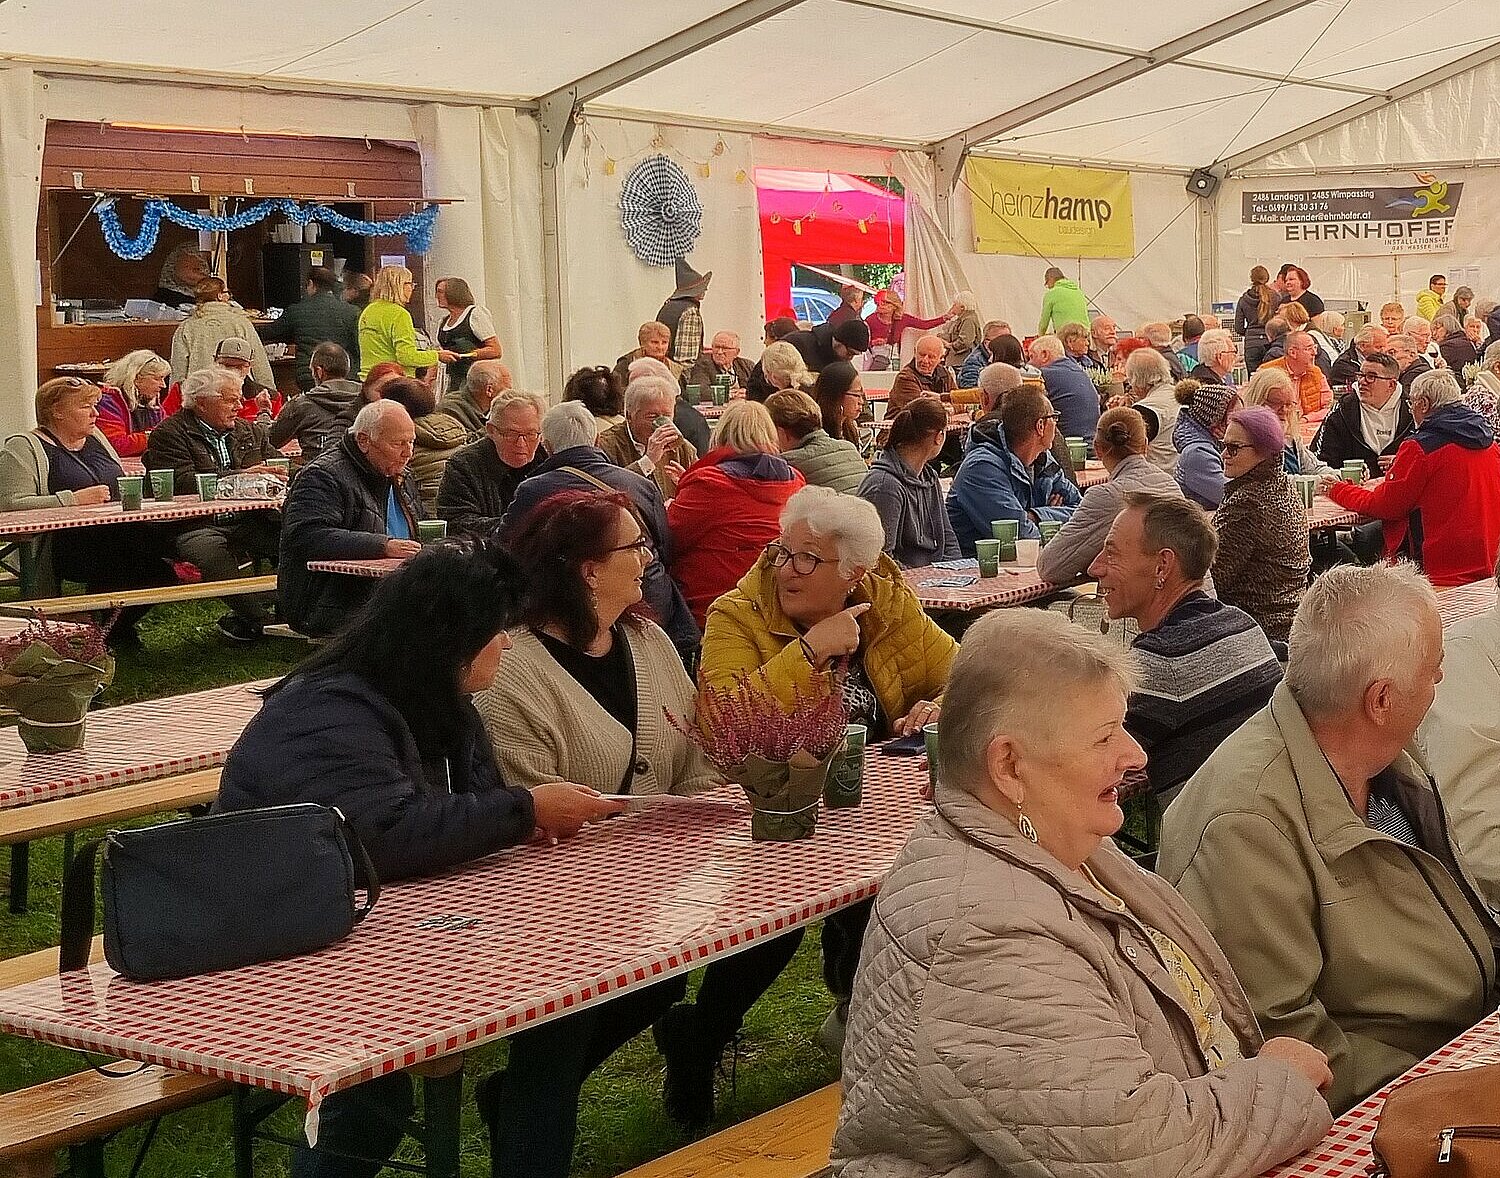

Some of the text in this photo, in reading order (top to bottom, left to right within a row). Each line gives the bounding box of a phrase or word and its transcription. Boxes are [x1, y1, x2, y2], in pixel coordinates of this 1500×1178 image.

[1271, 192, 1304, 202] Landegg
[1311, 190, 1330, 200] 2485
[1330, 189, 1375, 200] Wimpassing
[990, 183, 1112, 229] heinzhamp
[1320, 202, 1329, 210] 76
[1280, 210, 1371, 222] alexander@ehrnhofer.at
